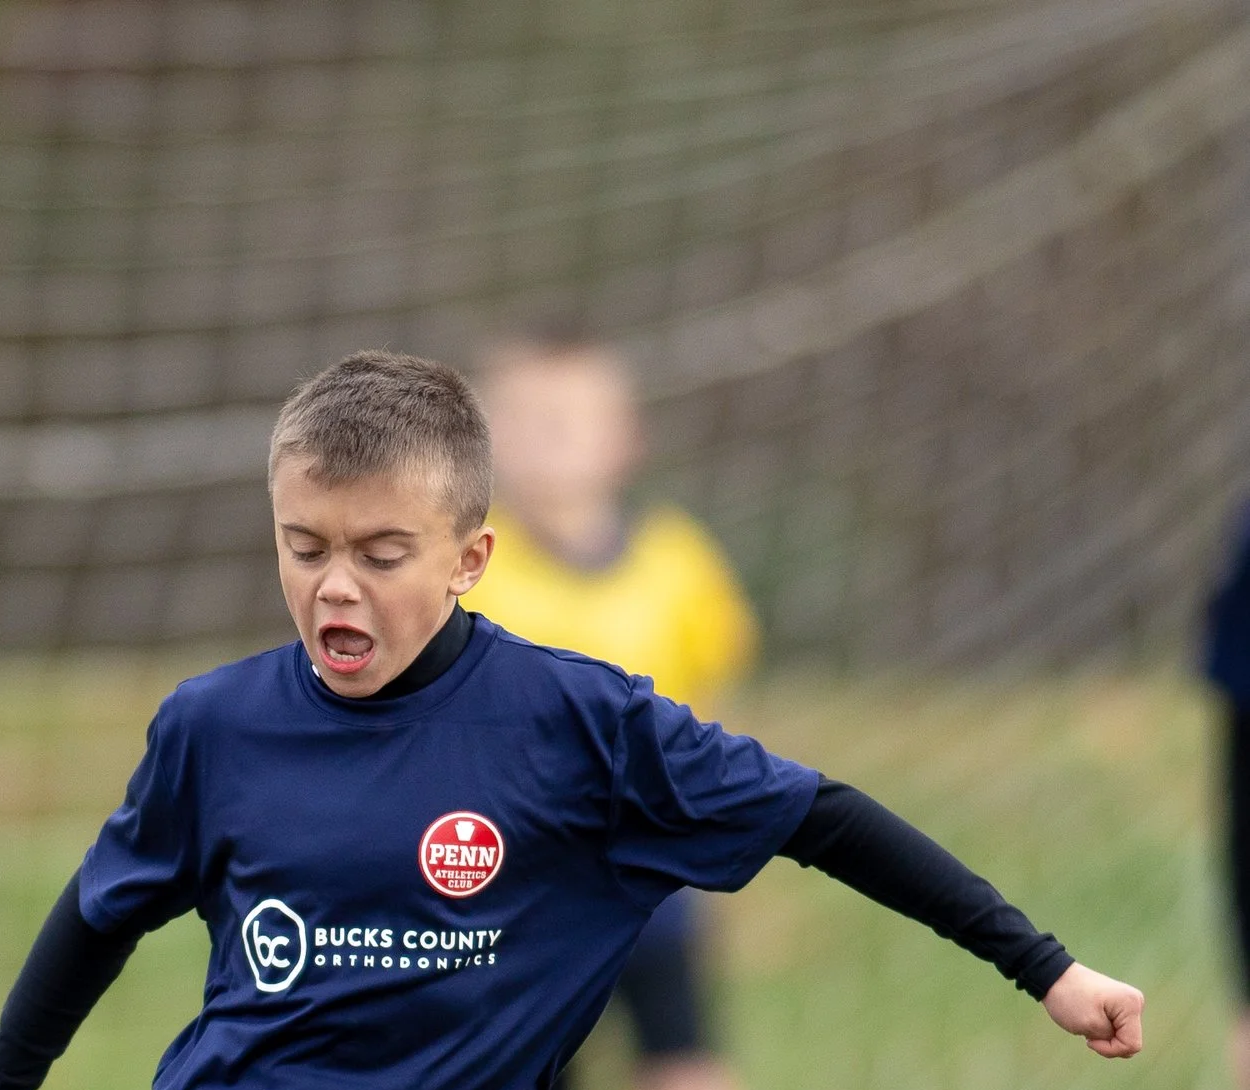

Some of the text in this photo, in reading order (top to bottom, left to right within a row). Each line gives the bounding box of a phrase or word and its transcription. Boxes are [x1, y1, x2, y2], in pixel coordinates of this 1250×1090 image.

[429, 843, 497, 867] PENN
[434, 869, 487, 880] ATHLETICS
[447, 879, 473, 889] CLUB
[314, 928, 502, 950] BUCKS COUNTY
[314, 953, 496, 970] ORTHODONTICS
